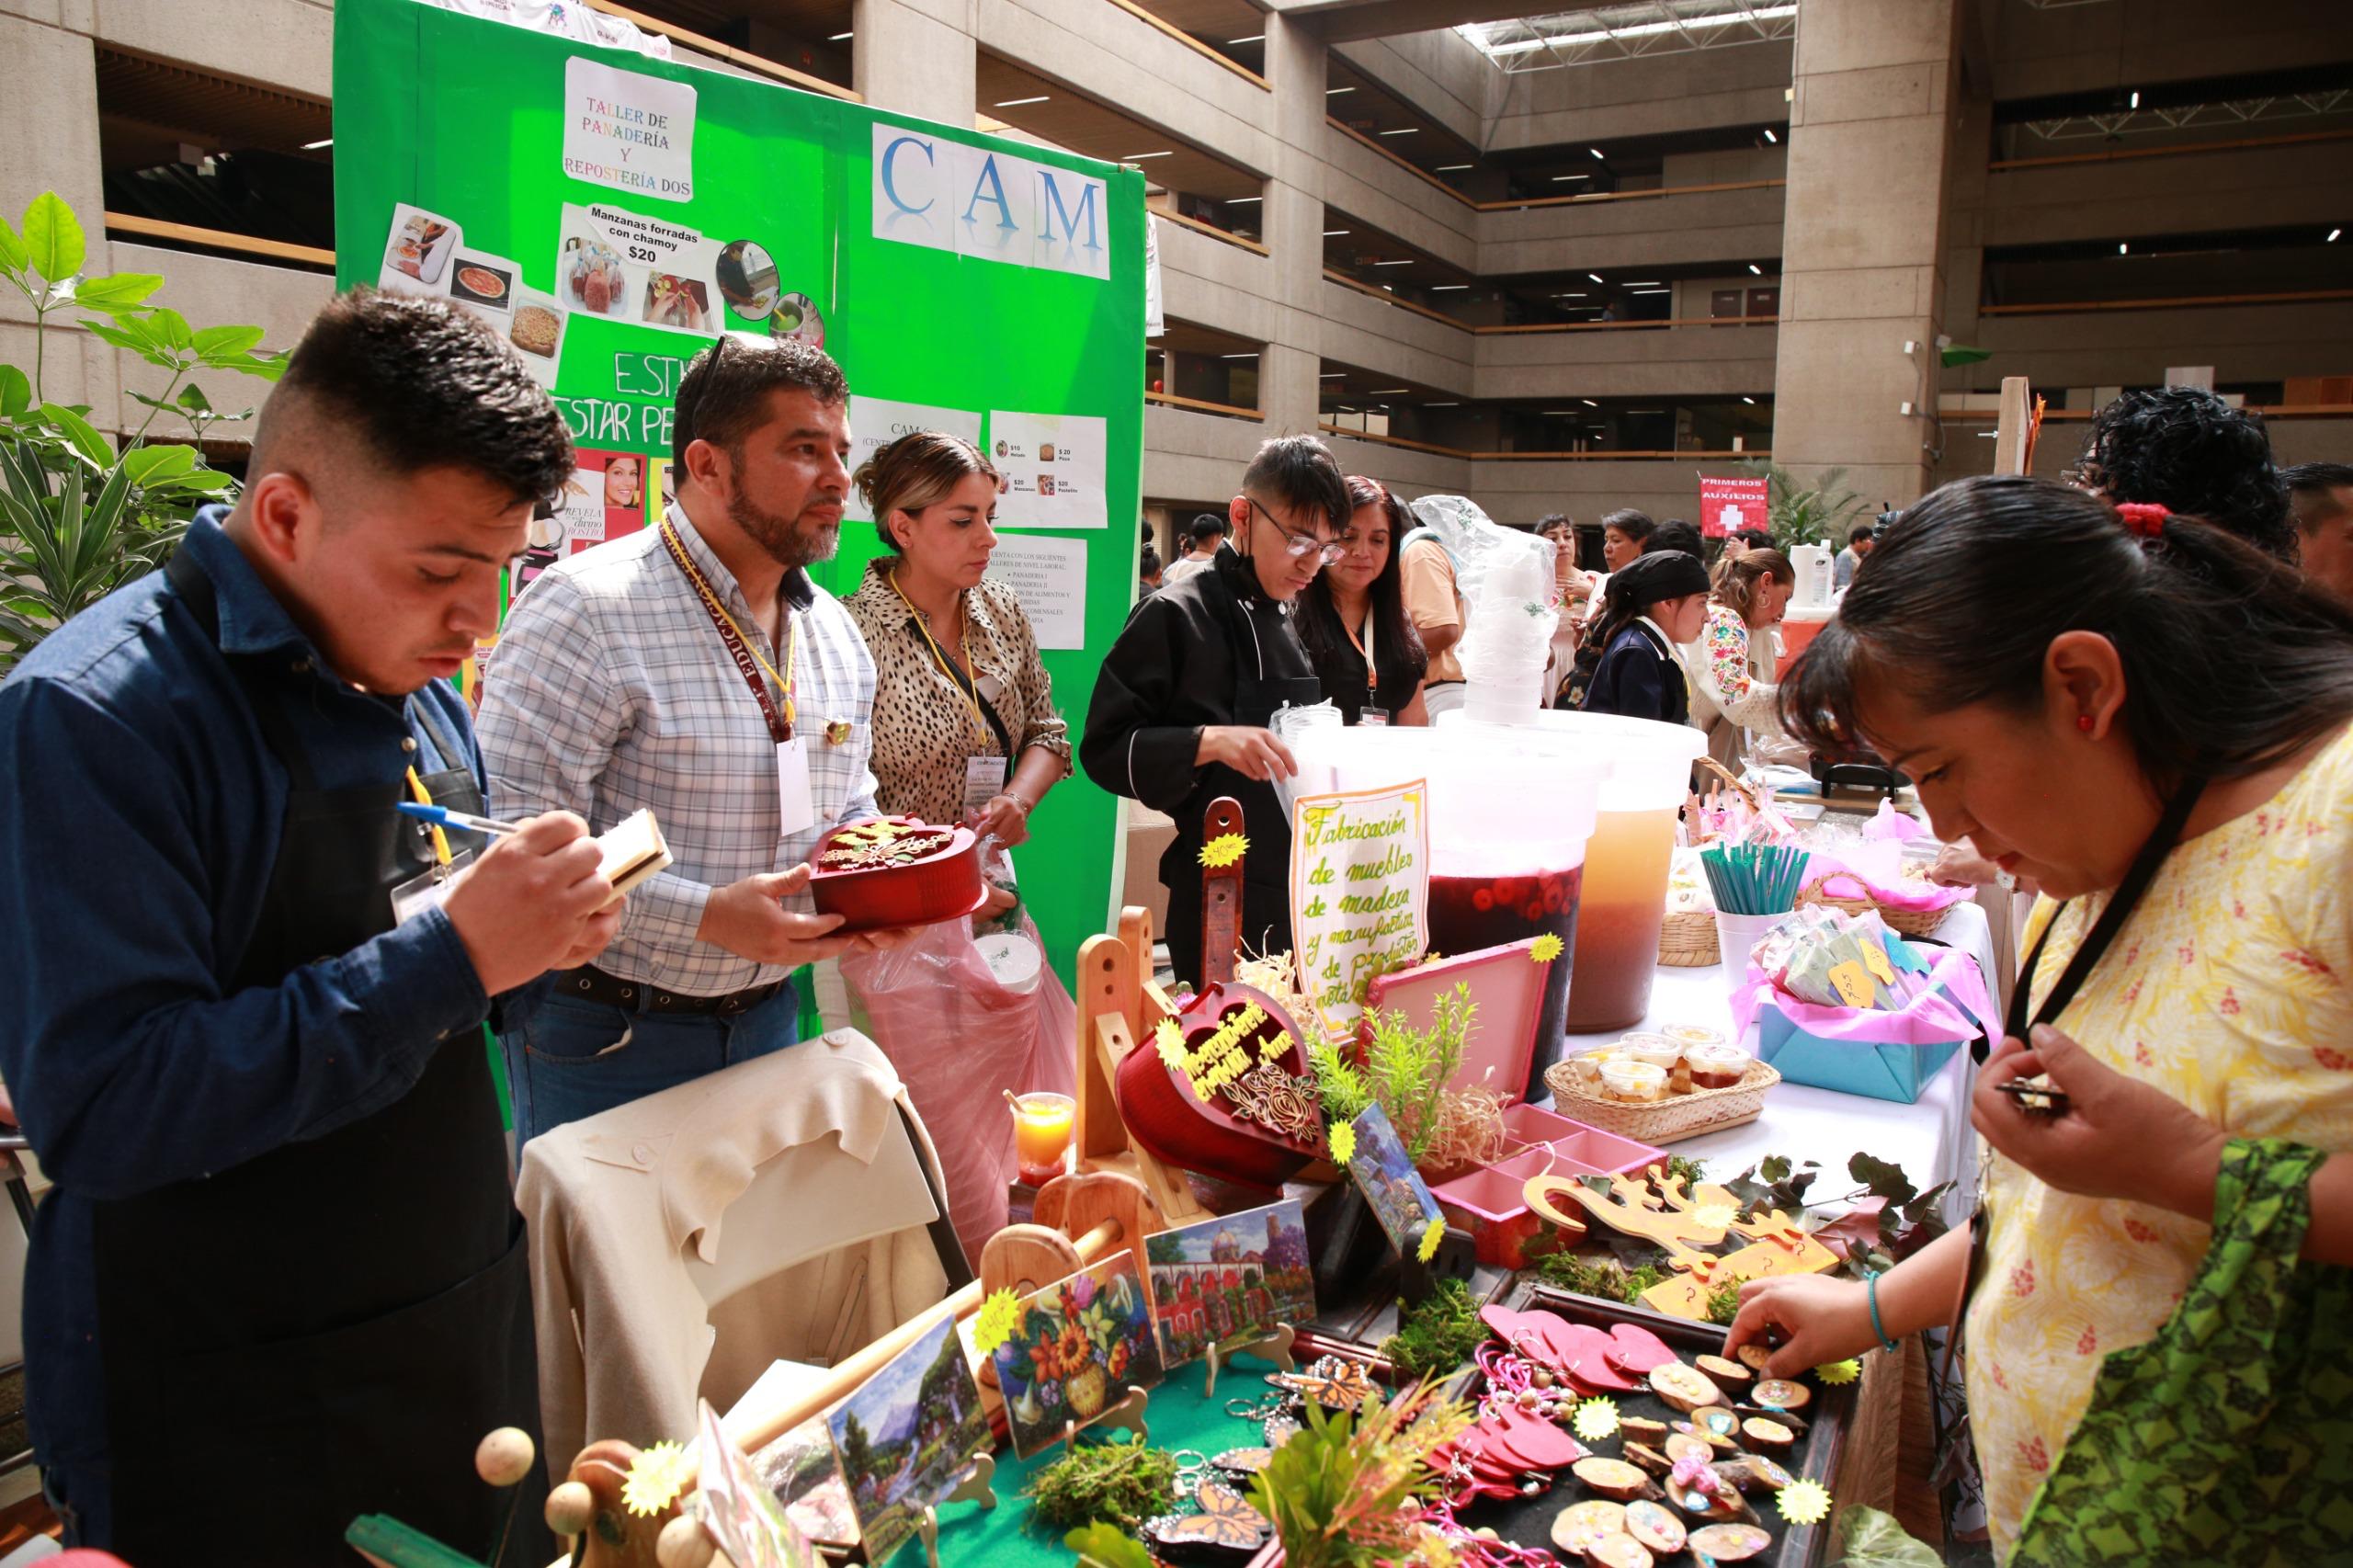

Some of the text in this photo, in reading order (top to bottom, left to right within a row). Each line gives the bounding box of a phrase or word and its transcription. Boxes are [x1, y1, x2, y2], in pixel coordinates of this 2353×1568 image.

[586, 97, 668, 129] TALLER DE
[582, 117, 669, 150] PANADERÍA
[620, 148, 631, 162] Y
[564, 157, 690, 196] REPOSTERÍA DOS
[881, 137, 1103, 251] CAM
[591, 207, 698, 244] Manzanas forradas
[608, 227, 677, 252] con chamoy
[629, 245, 656, 263] $20
[1701, 478, 1762, 487] PRIMEROS
[1702, 492, 1766, 501] AUXILIOS
[1303, 801, 1405, 846] Fabricación
[1308, 843, 1413, 885] de muebles
[1303, 884, 1410, 918] de madera
[1329, 910, 1414, 947] manufactura
[1322, 955, 1340, 979] de
